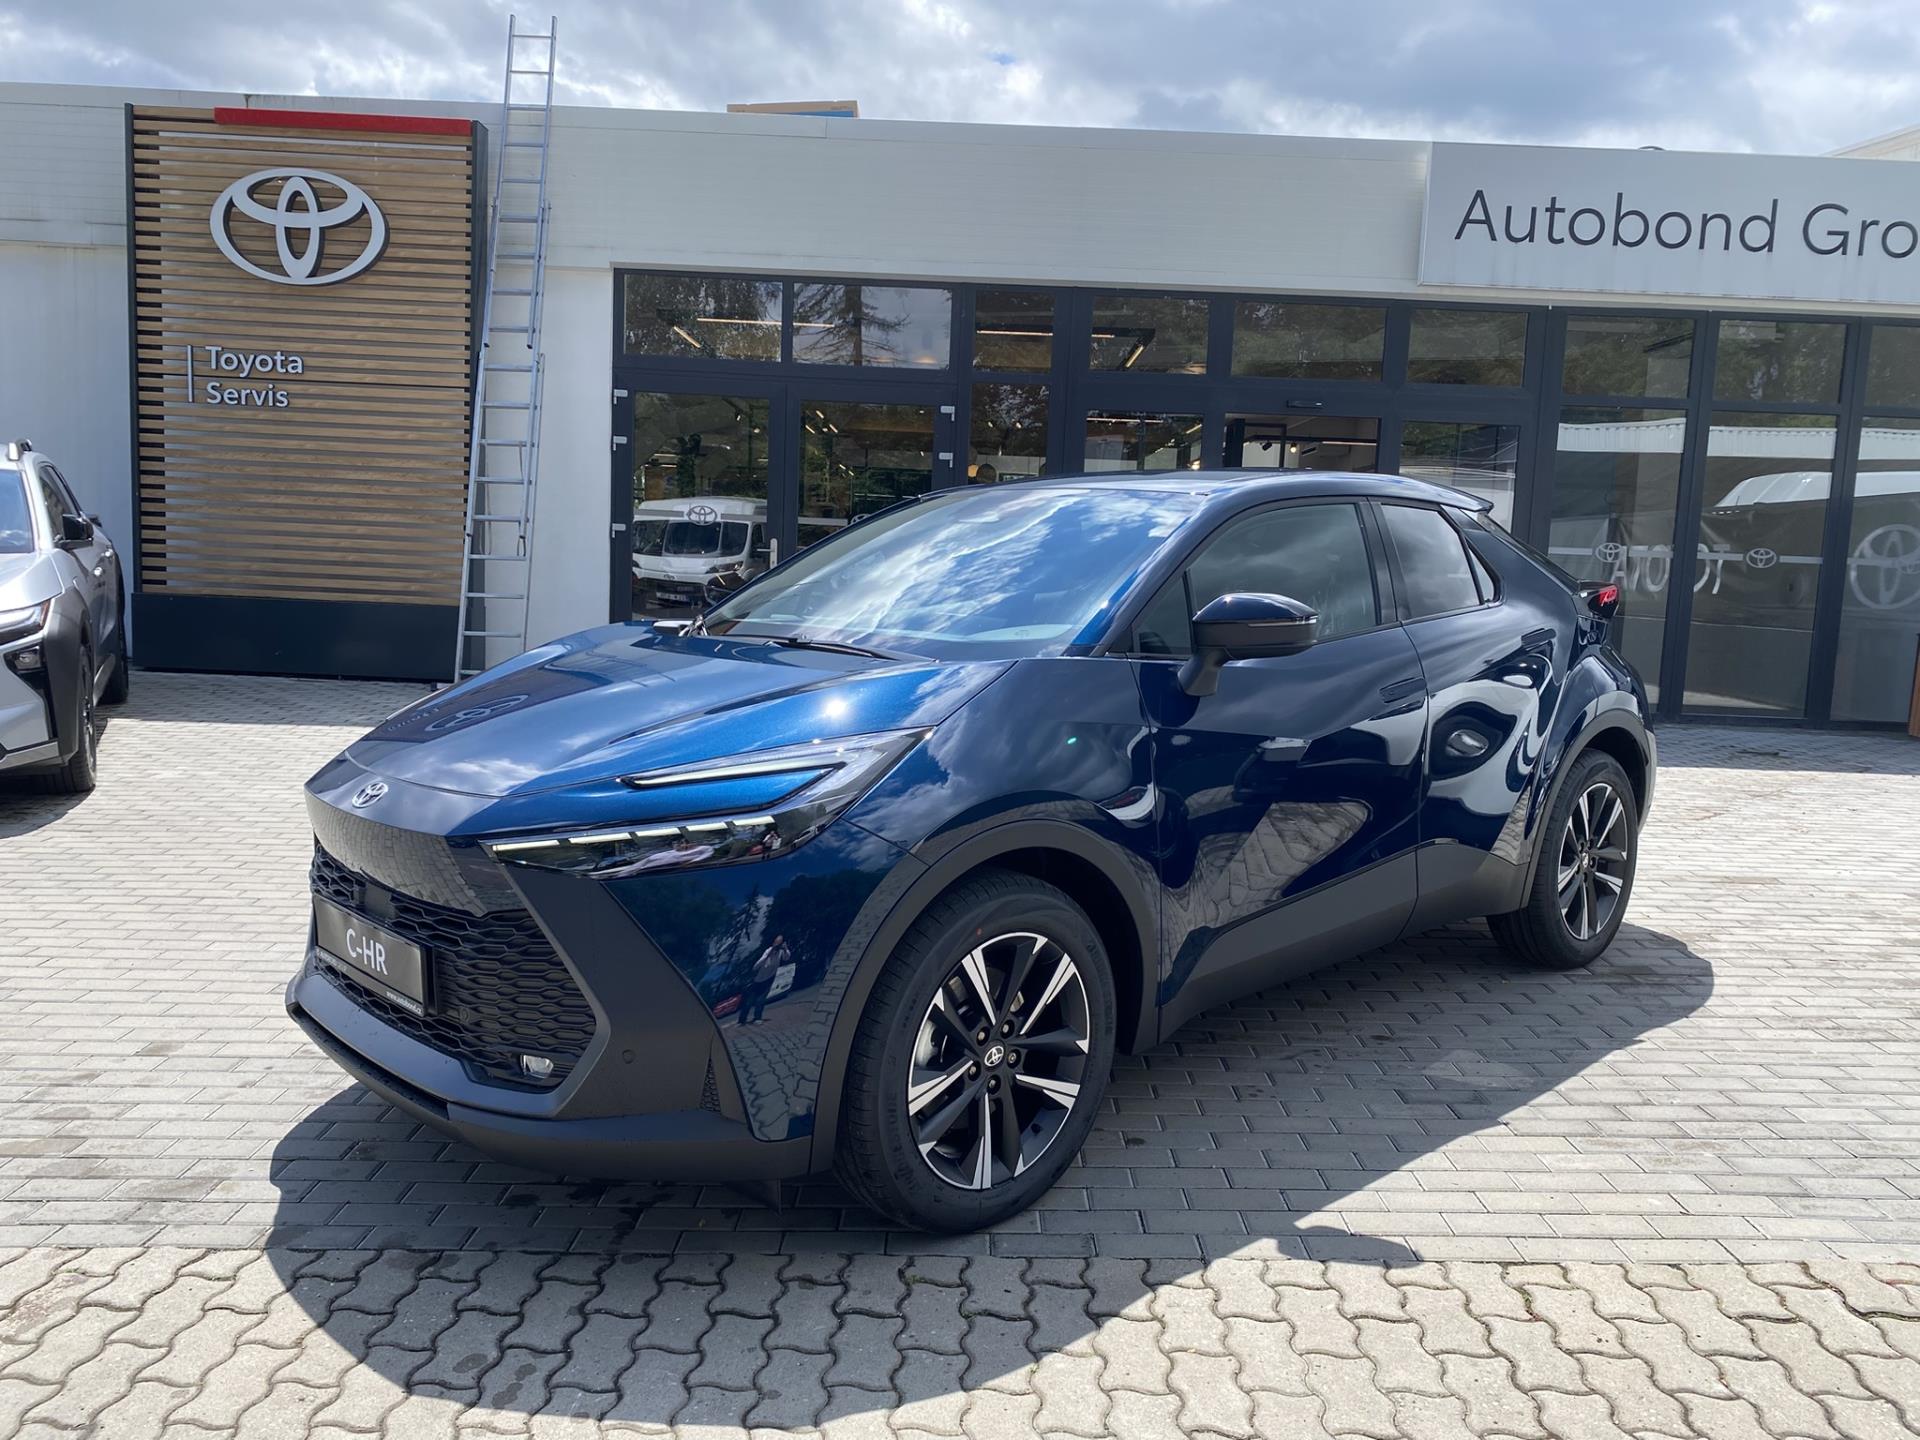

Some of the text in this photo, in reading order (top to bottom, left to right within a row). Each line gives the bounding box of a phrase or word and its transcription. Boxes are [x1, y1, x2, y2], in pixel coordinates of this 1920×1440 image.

[1454, 189, 1919, 259] Autobond Gro
[205, 345, 304, 378] Toyota
[206, 382, 290, 407] Servis
[346, 928, 388, 976] C-HR
